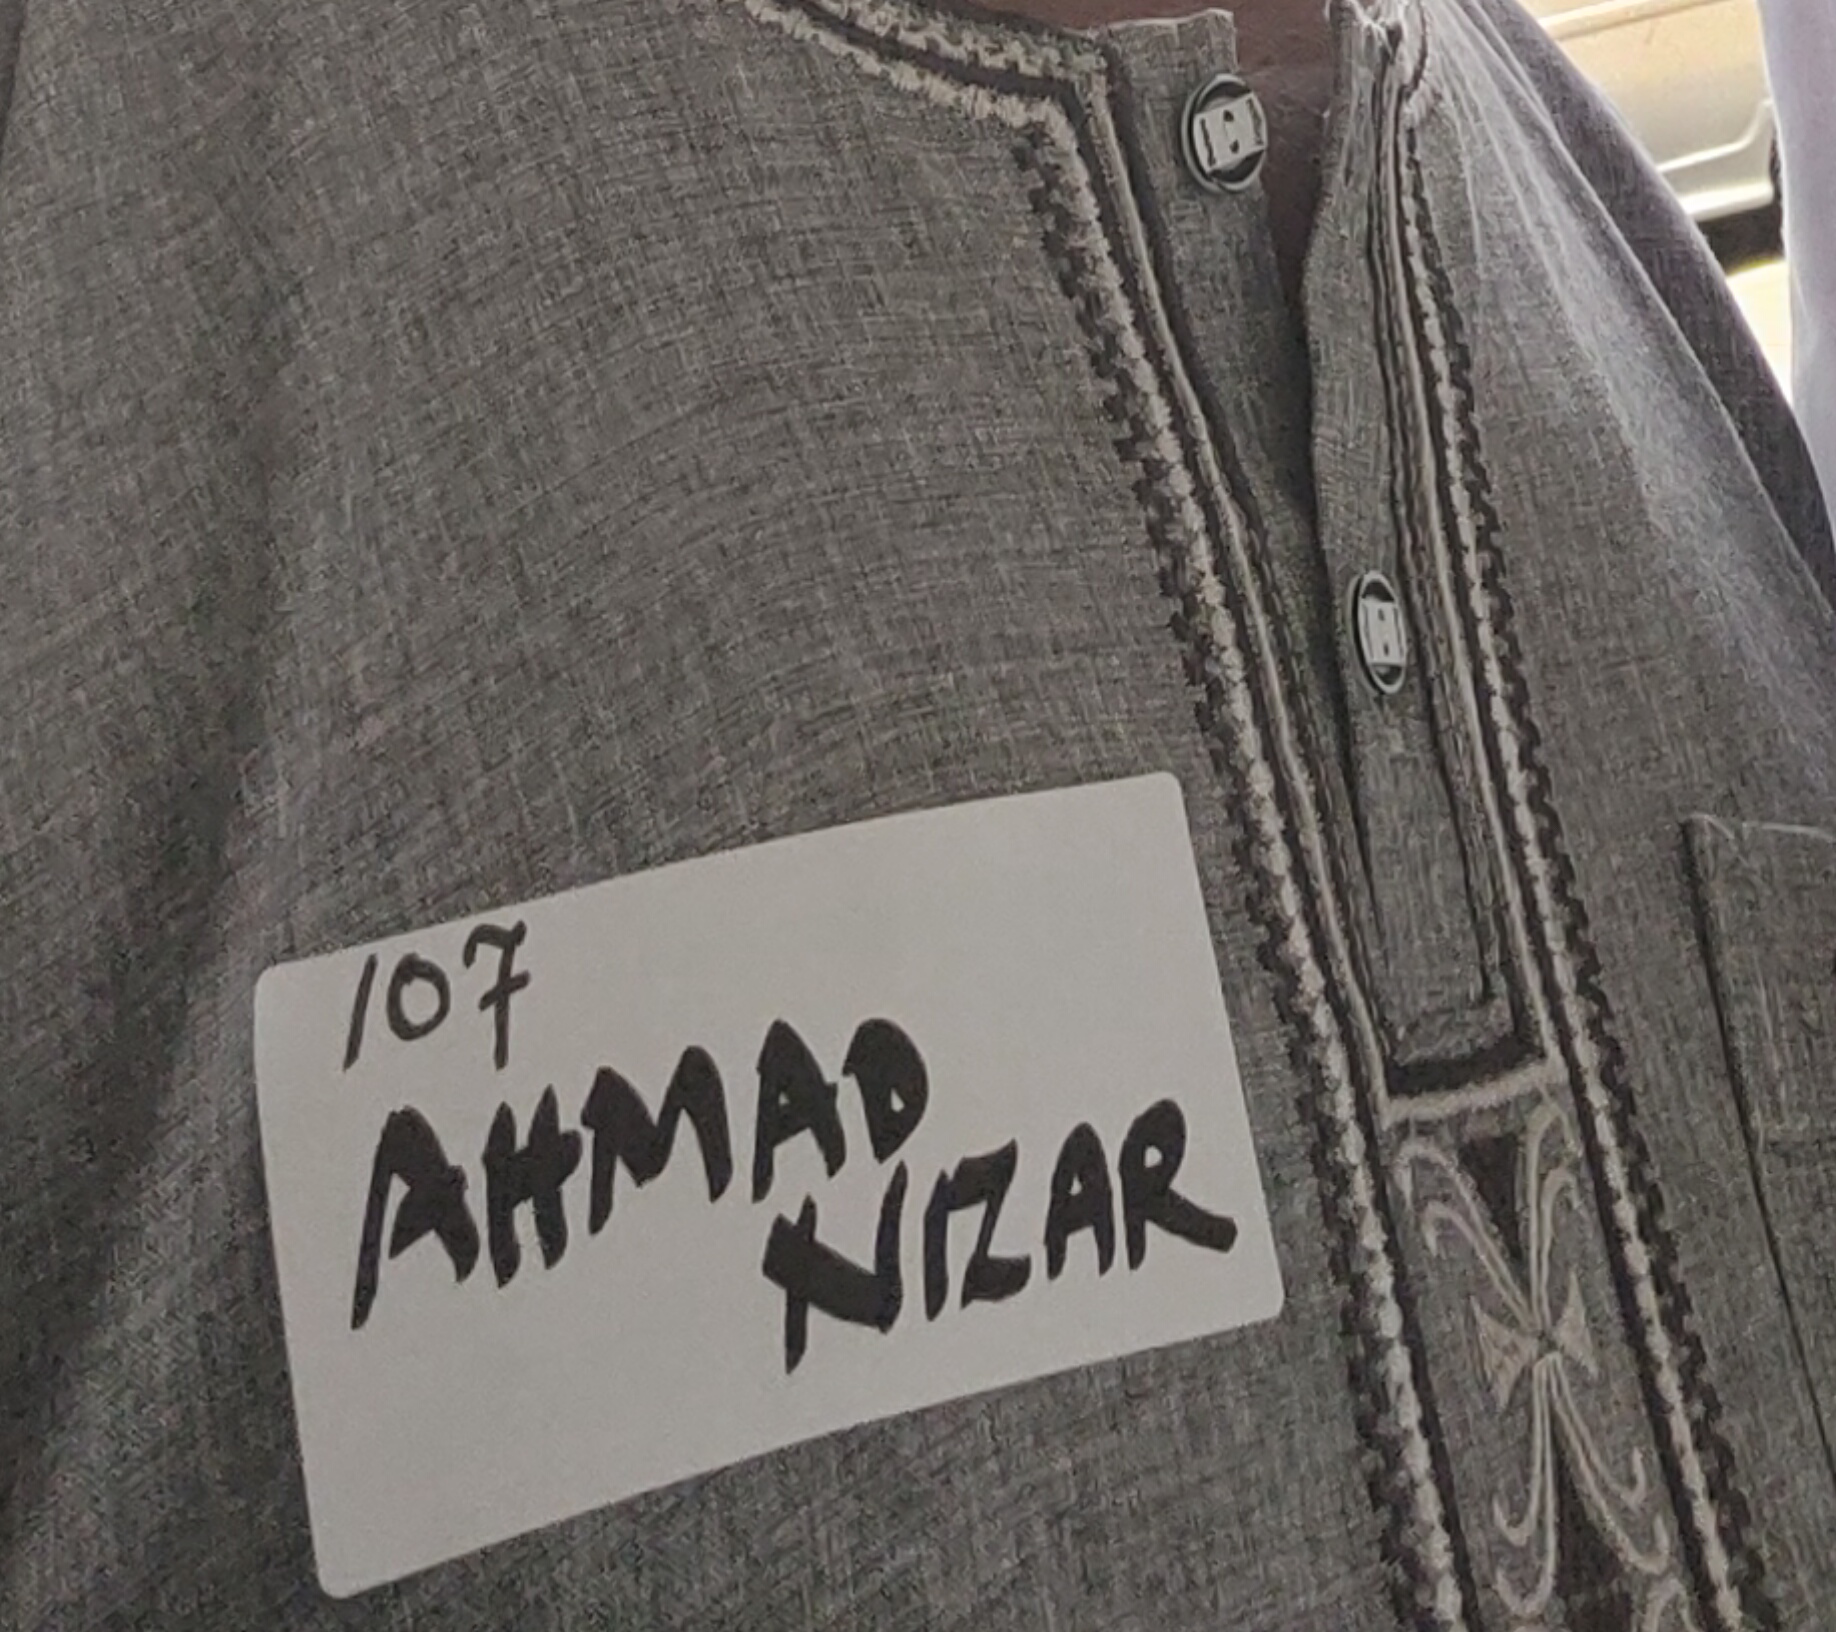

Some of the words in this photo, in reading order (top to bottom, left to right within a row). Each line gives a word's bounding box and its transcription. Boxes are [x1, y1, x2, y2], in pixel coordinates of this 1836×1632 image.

[342, 920, 531, 1072] 107
[350, 1017, 930, 1331] AHMAD
[760, 1097, 1240, 1376] NIZAR
